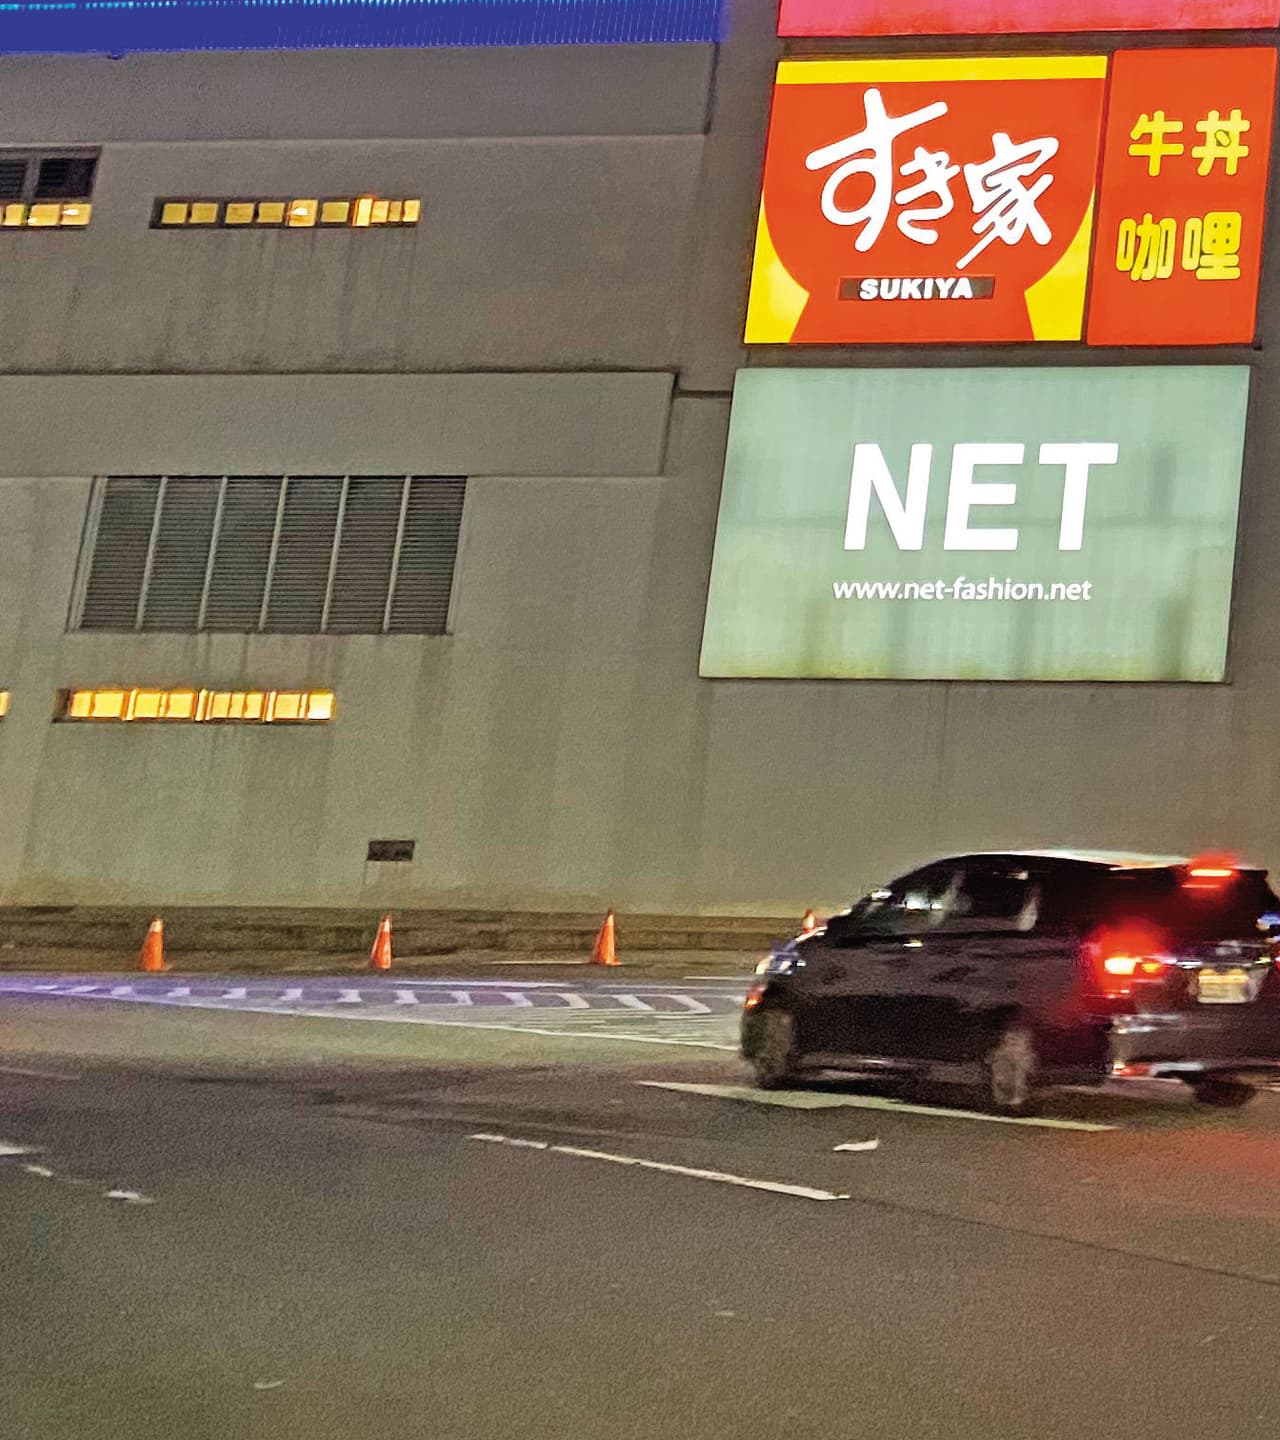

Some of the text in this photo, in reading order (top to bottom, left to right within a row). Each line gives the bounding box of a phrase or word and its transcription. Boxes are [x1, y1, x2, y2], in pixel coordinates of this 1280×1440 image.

[806, 87, 1060, 270] すき家
[1128, 109, 1252, 178] 牛丼
[1115, 211, 1243, 283] 咖哩
[859, 277, 974, 301] SUKIYA
[843, 443, 1120, 552] NET
[833, 576, 1092, 603] www.net-fashion.net
